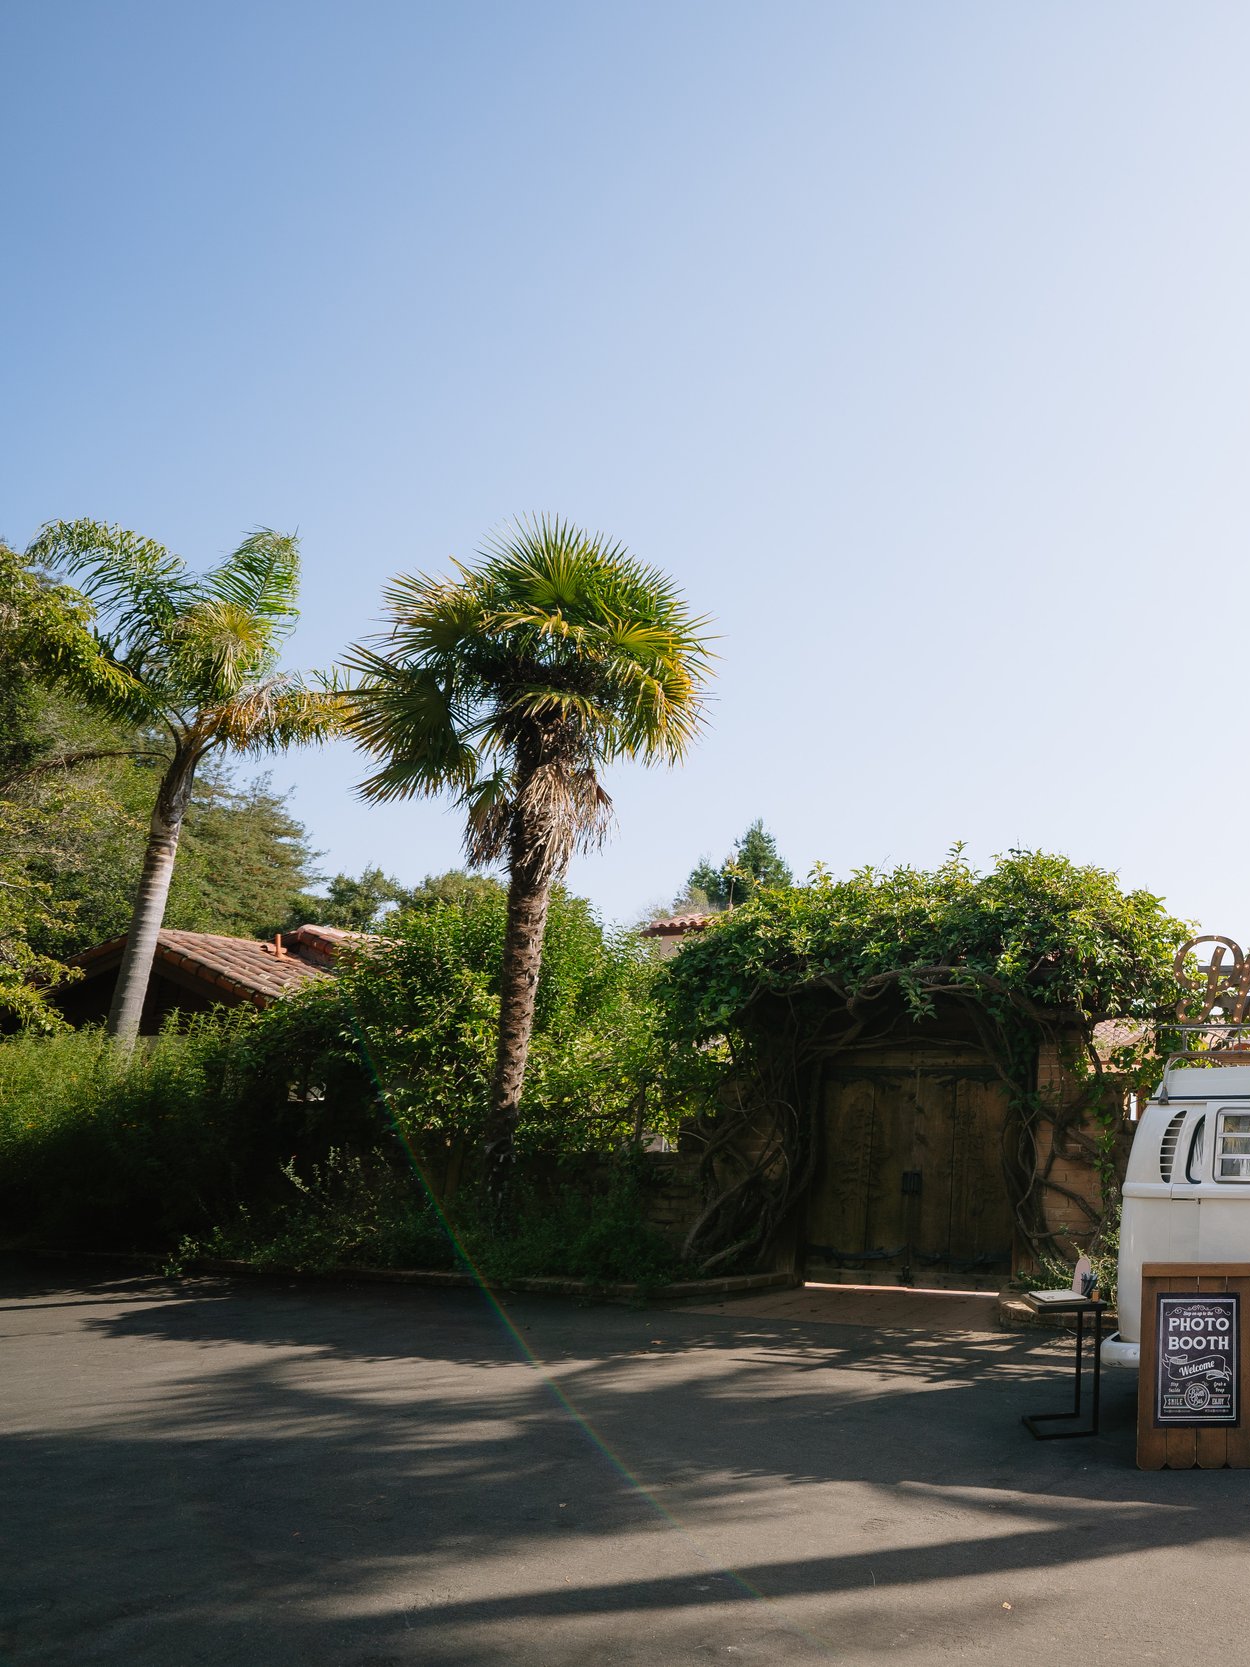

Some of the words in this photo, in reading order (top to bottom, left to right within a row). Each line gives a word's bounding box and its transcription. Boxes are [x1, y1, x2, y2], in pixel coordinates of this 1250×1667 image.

[1168, 1317, 1230, 1331] PHOTO
[1168, 1336, 1229, 1350] BOOTH
[1178, 1360, 1215, 1376] Welcome
